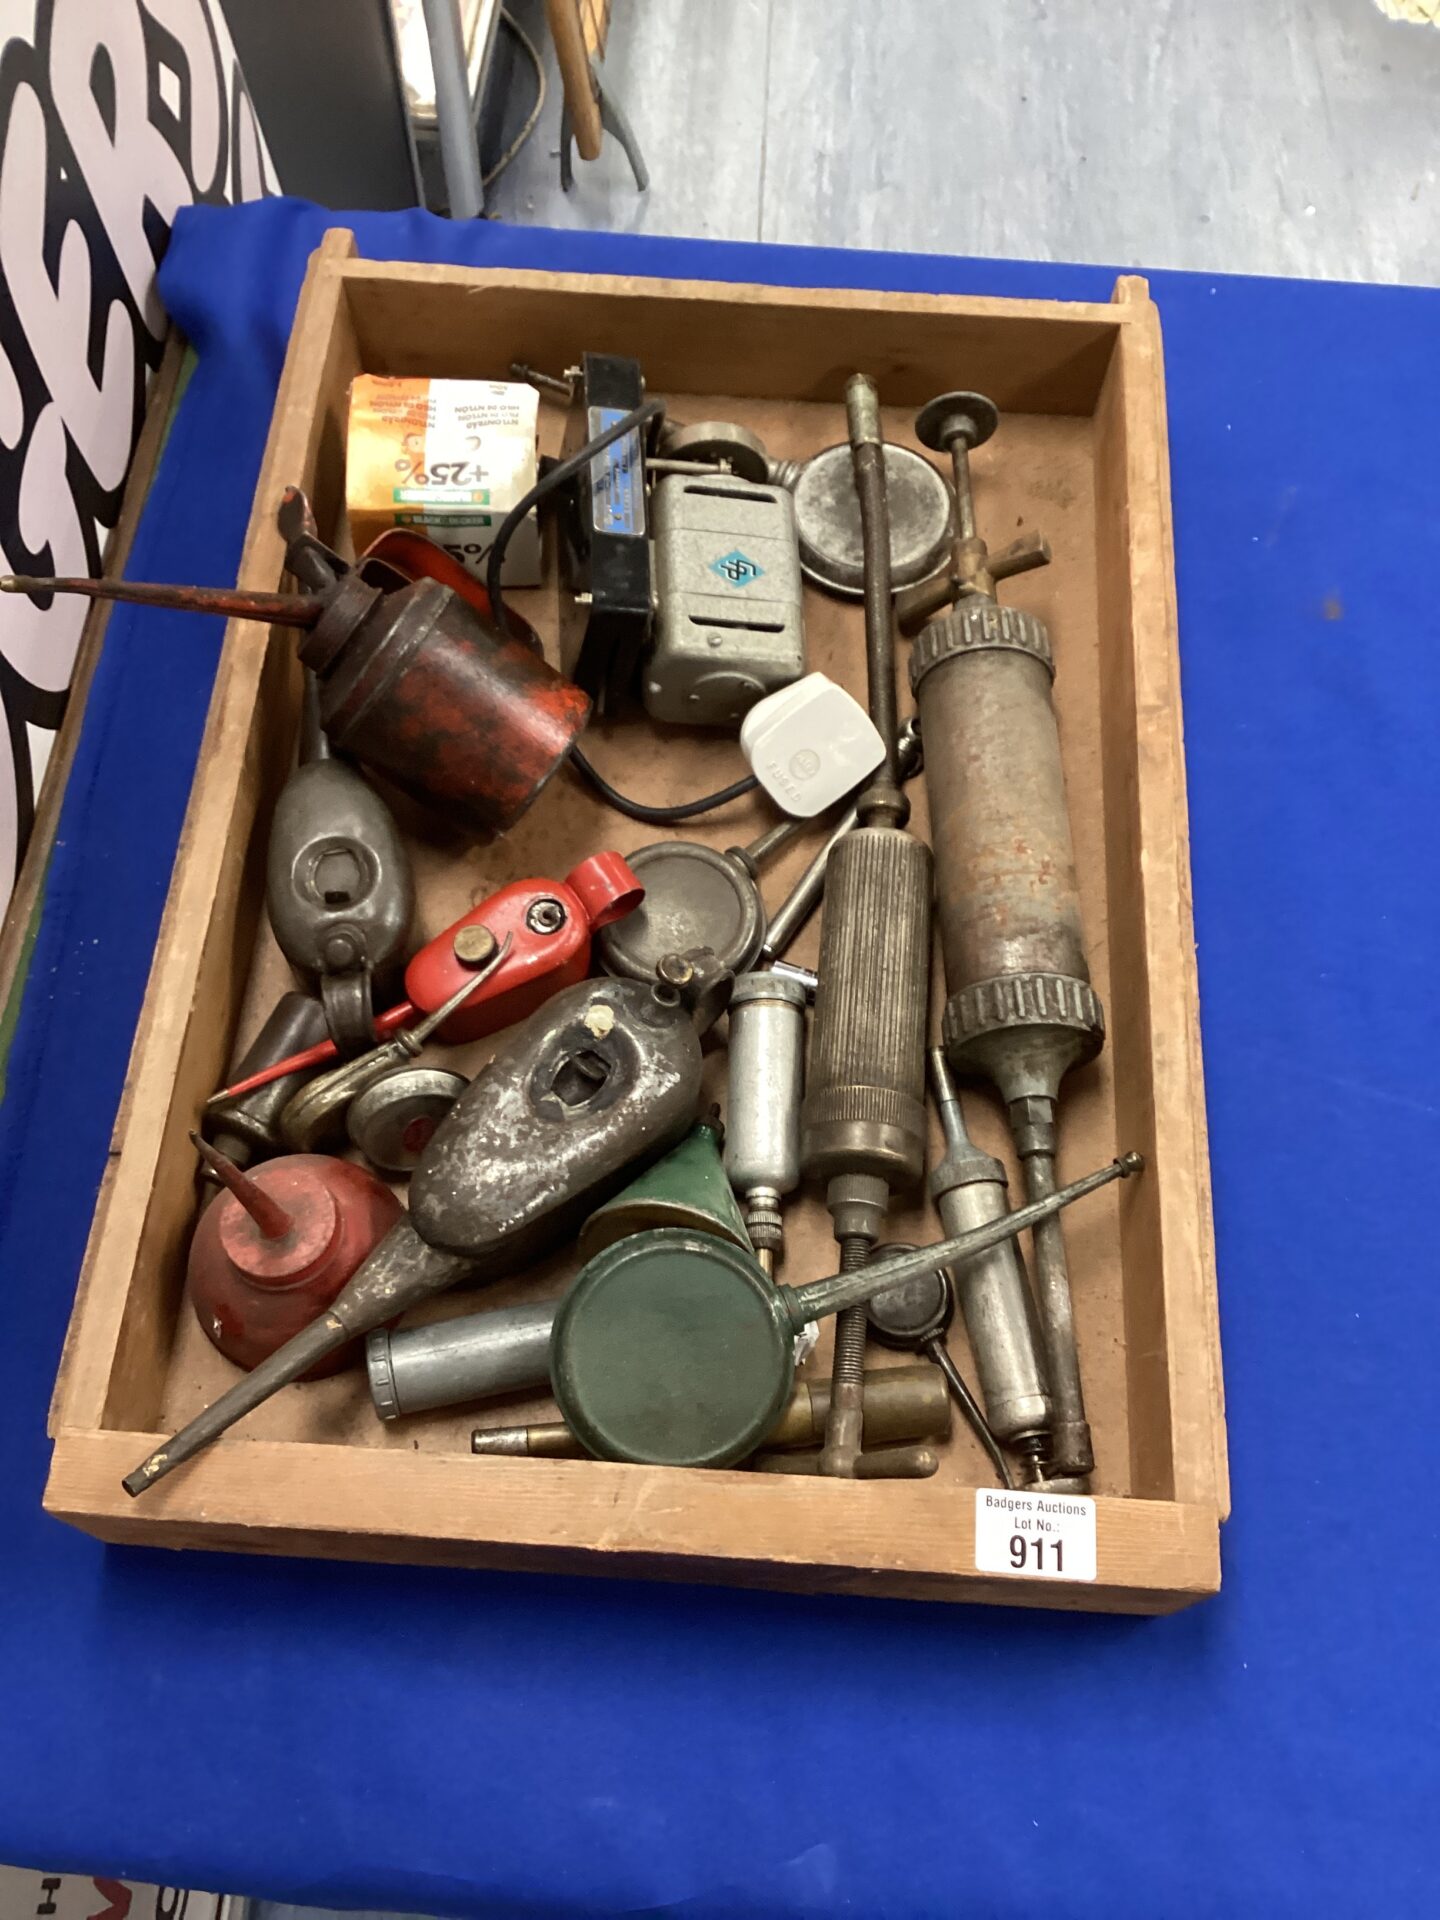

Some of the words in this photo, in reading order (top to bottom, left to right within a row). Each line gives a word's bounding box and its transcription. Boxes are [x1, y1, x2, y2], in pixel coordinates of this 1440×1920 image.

[395, 461, 490, 487] +25%
[986, 1495, 1033, 1512] Badgers
[1037, 1500, 1087, 1516] Auctions
[1014, 1517, 1032, 1530] Lot
[1009, 1534, 1063, 1572] 911
